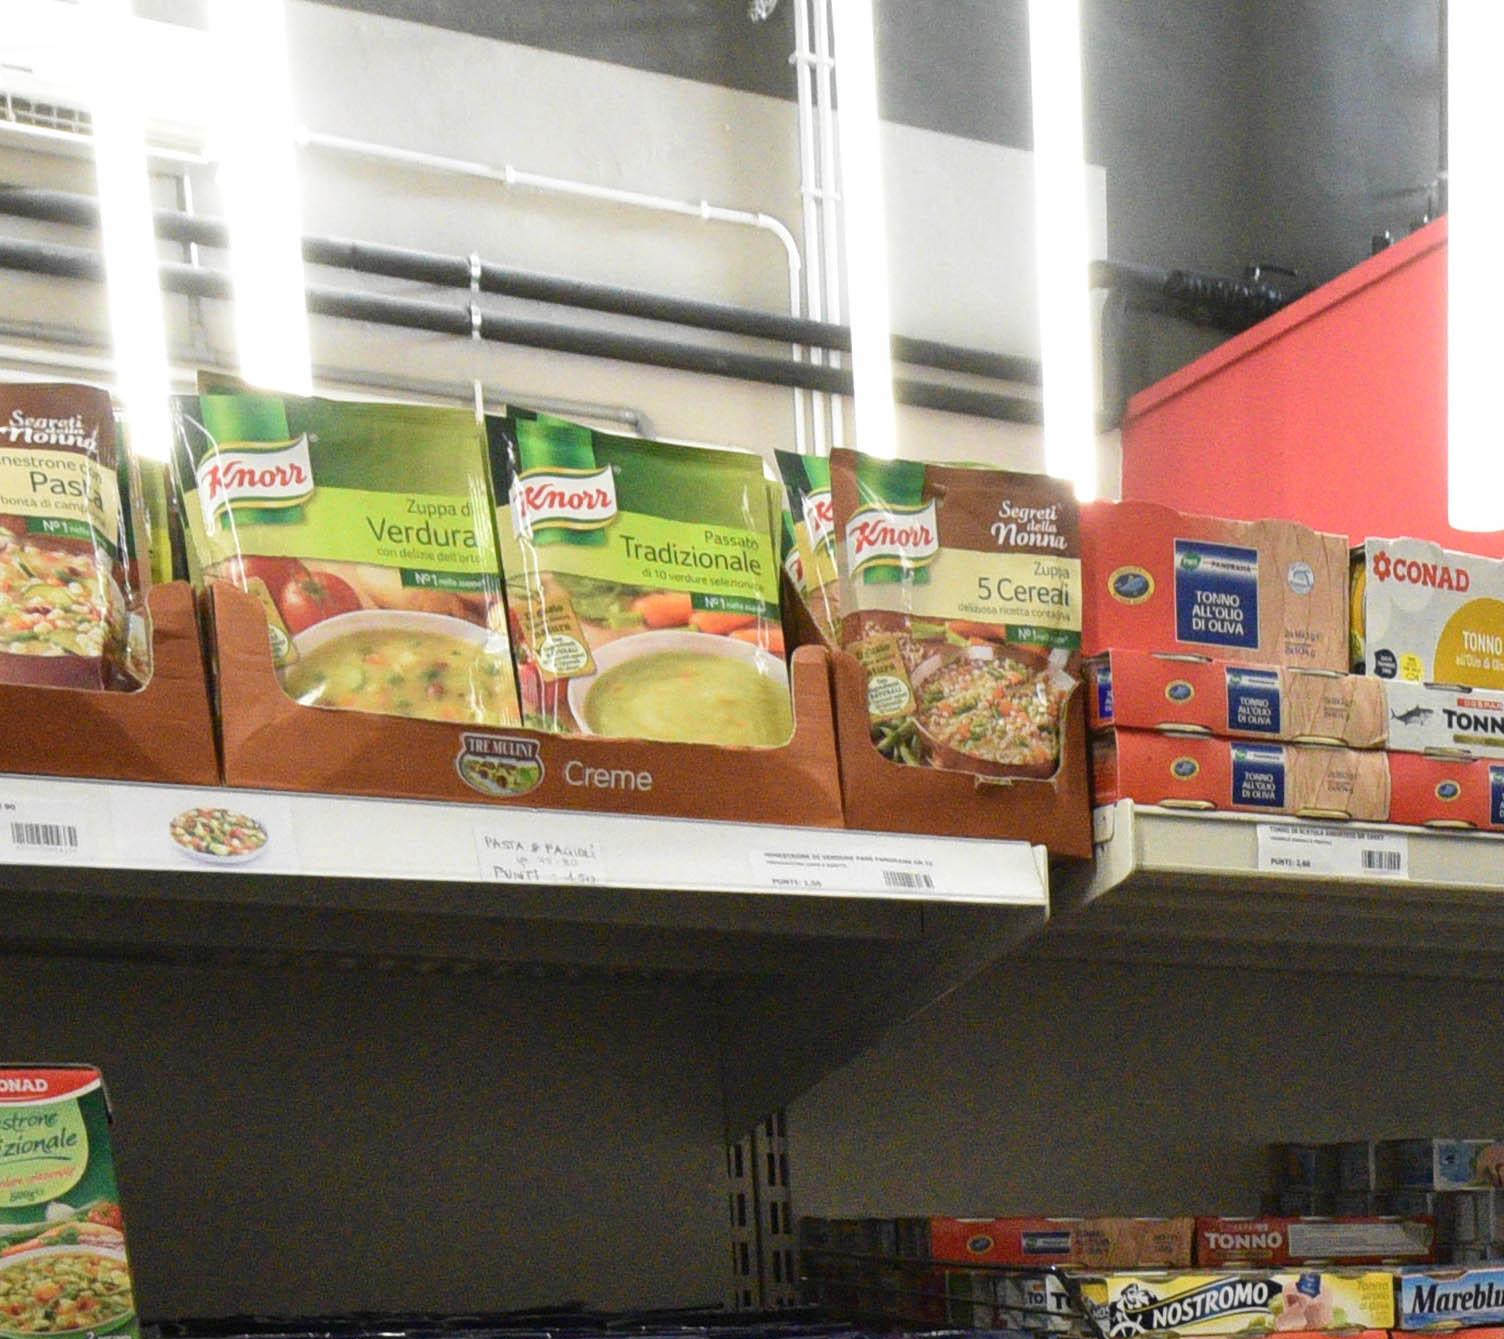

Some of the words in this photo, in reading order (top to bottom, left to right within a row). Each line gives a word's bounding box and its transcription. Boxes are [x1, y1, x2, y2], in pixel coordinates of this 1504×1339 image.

[201, 461, 307, 499] Knorr
[407, 499, 456, 518] Zuppa
[520, 482, 611, 517] Knorr
[998, 501, 1057, 522] Segreti
[366, 517, 478, 548] Verdura
[855, 520, 933, 553] Knorr
[991, 523, 1067, 550] Nonna
[1027, 519, 1057, 534] della
[704, 530, 760, 550] Passato
[620, 535, 761, 576] Tradizionale
[1034, 561, 1070, 579] Zuppa
[1393, 562, 1470, 592] CONAD
[978, 577, 992, 600] 5
[997, 577, 1070, 607] Cereali
[1196, 591, 1240, 608] TONNO
[1192, 605, 1243, 621] ALL'OLIO
[1192, 619, 1207, 631] DI
[1209, 619, 1244, 635] OLIVA
[1463, 630, 1503, 655] TONNO
[1239, 697, 1270, 708] TONNO
[1238, 713, 1248, 723] DI
[1249, 714, 1271, 725] OLIVA
[468, 738, 490, 754] TRE
[494, 739, 534, 759] MULINI
[565, 760, 652, 791] Creme
[1152, 1282, 1268, 1328] NOSTROMO
